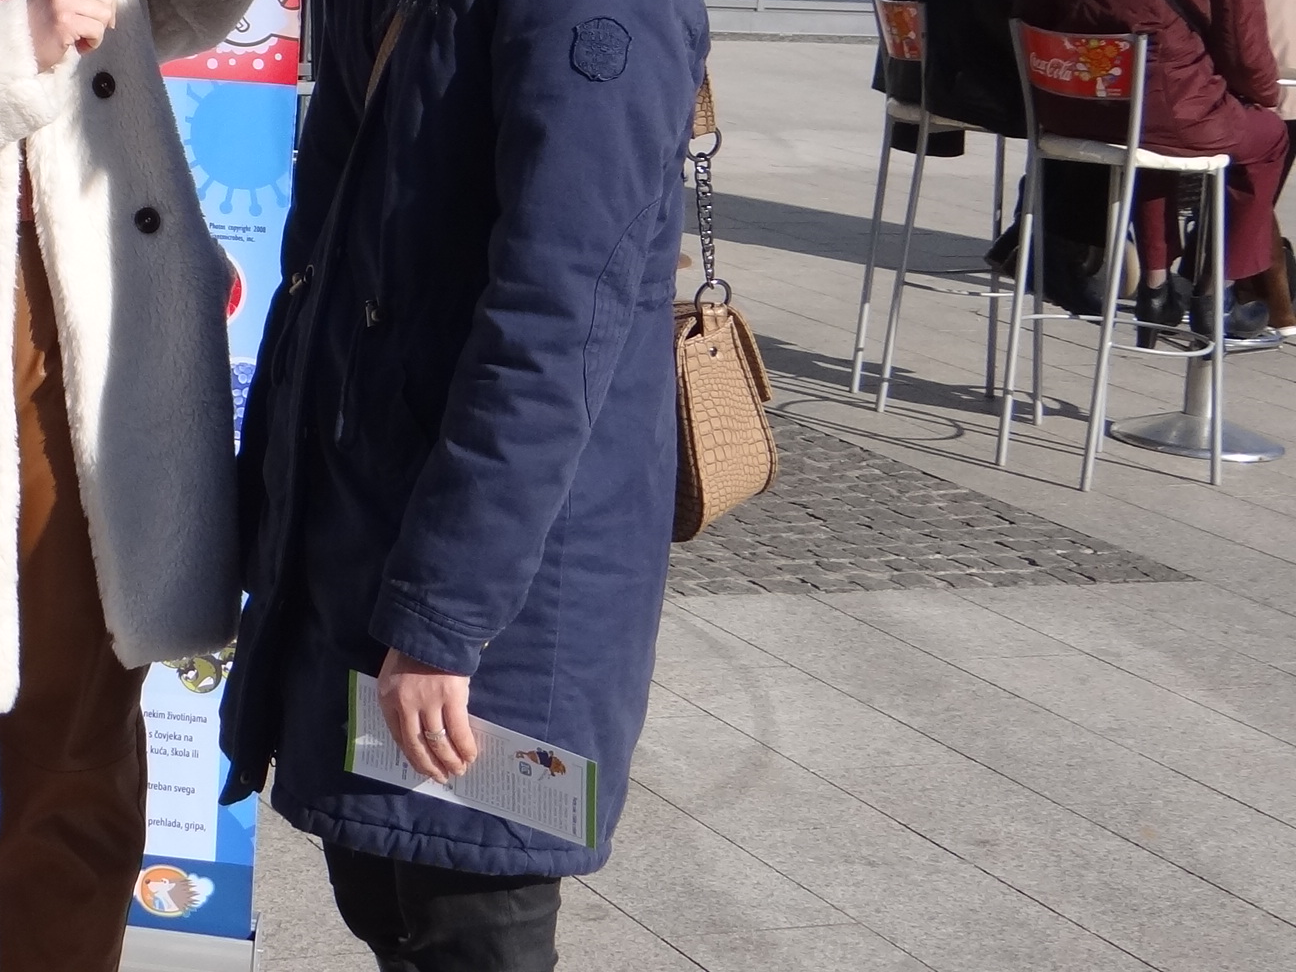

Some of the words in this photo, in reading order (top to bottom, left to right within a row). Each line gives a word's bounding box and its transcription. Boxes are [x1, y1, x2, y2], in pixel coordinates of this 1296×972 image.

[144, 709, 166, 719] nekim
[166, 711, 208, 724] životinjama
[154, 730, 182, 742] čovjeka
[183, 734, 193, 742] na
[150, 745, 170, 757] kuća,
[170, 747, 190, 758] škola
[173, 785, 196, 796] svega
[148, 817, 183, 829] prehlada,
[184, 821, 207, 833] gripa,
